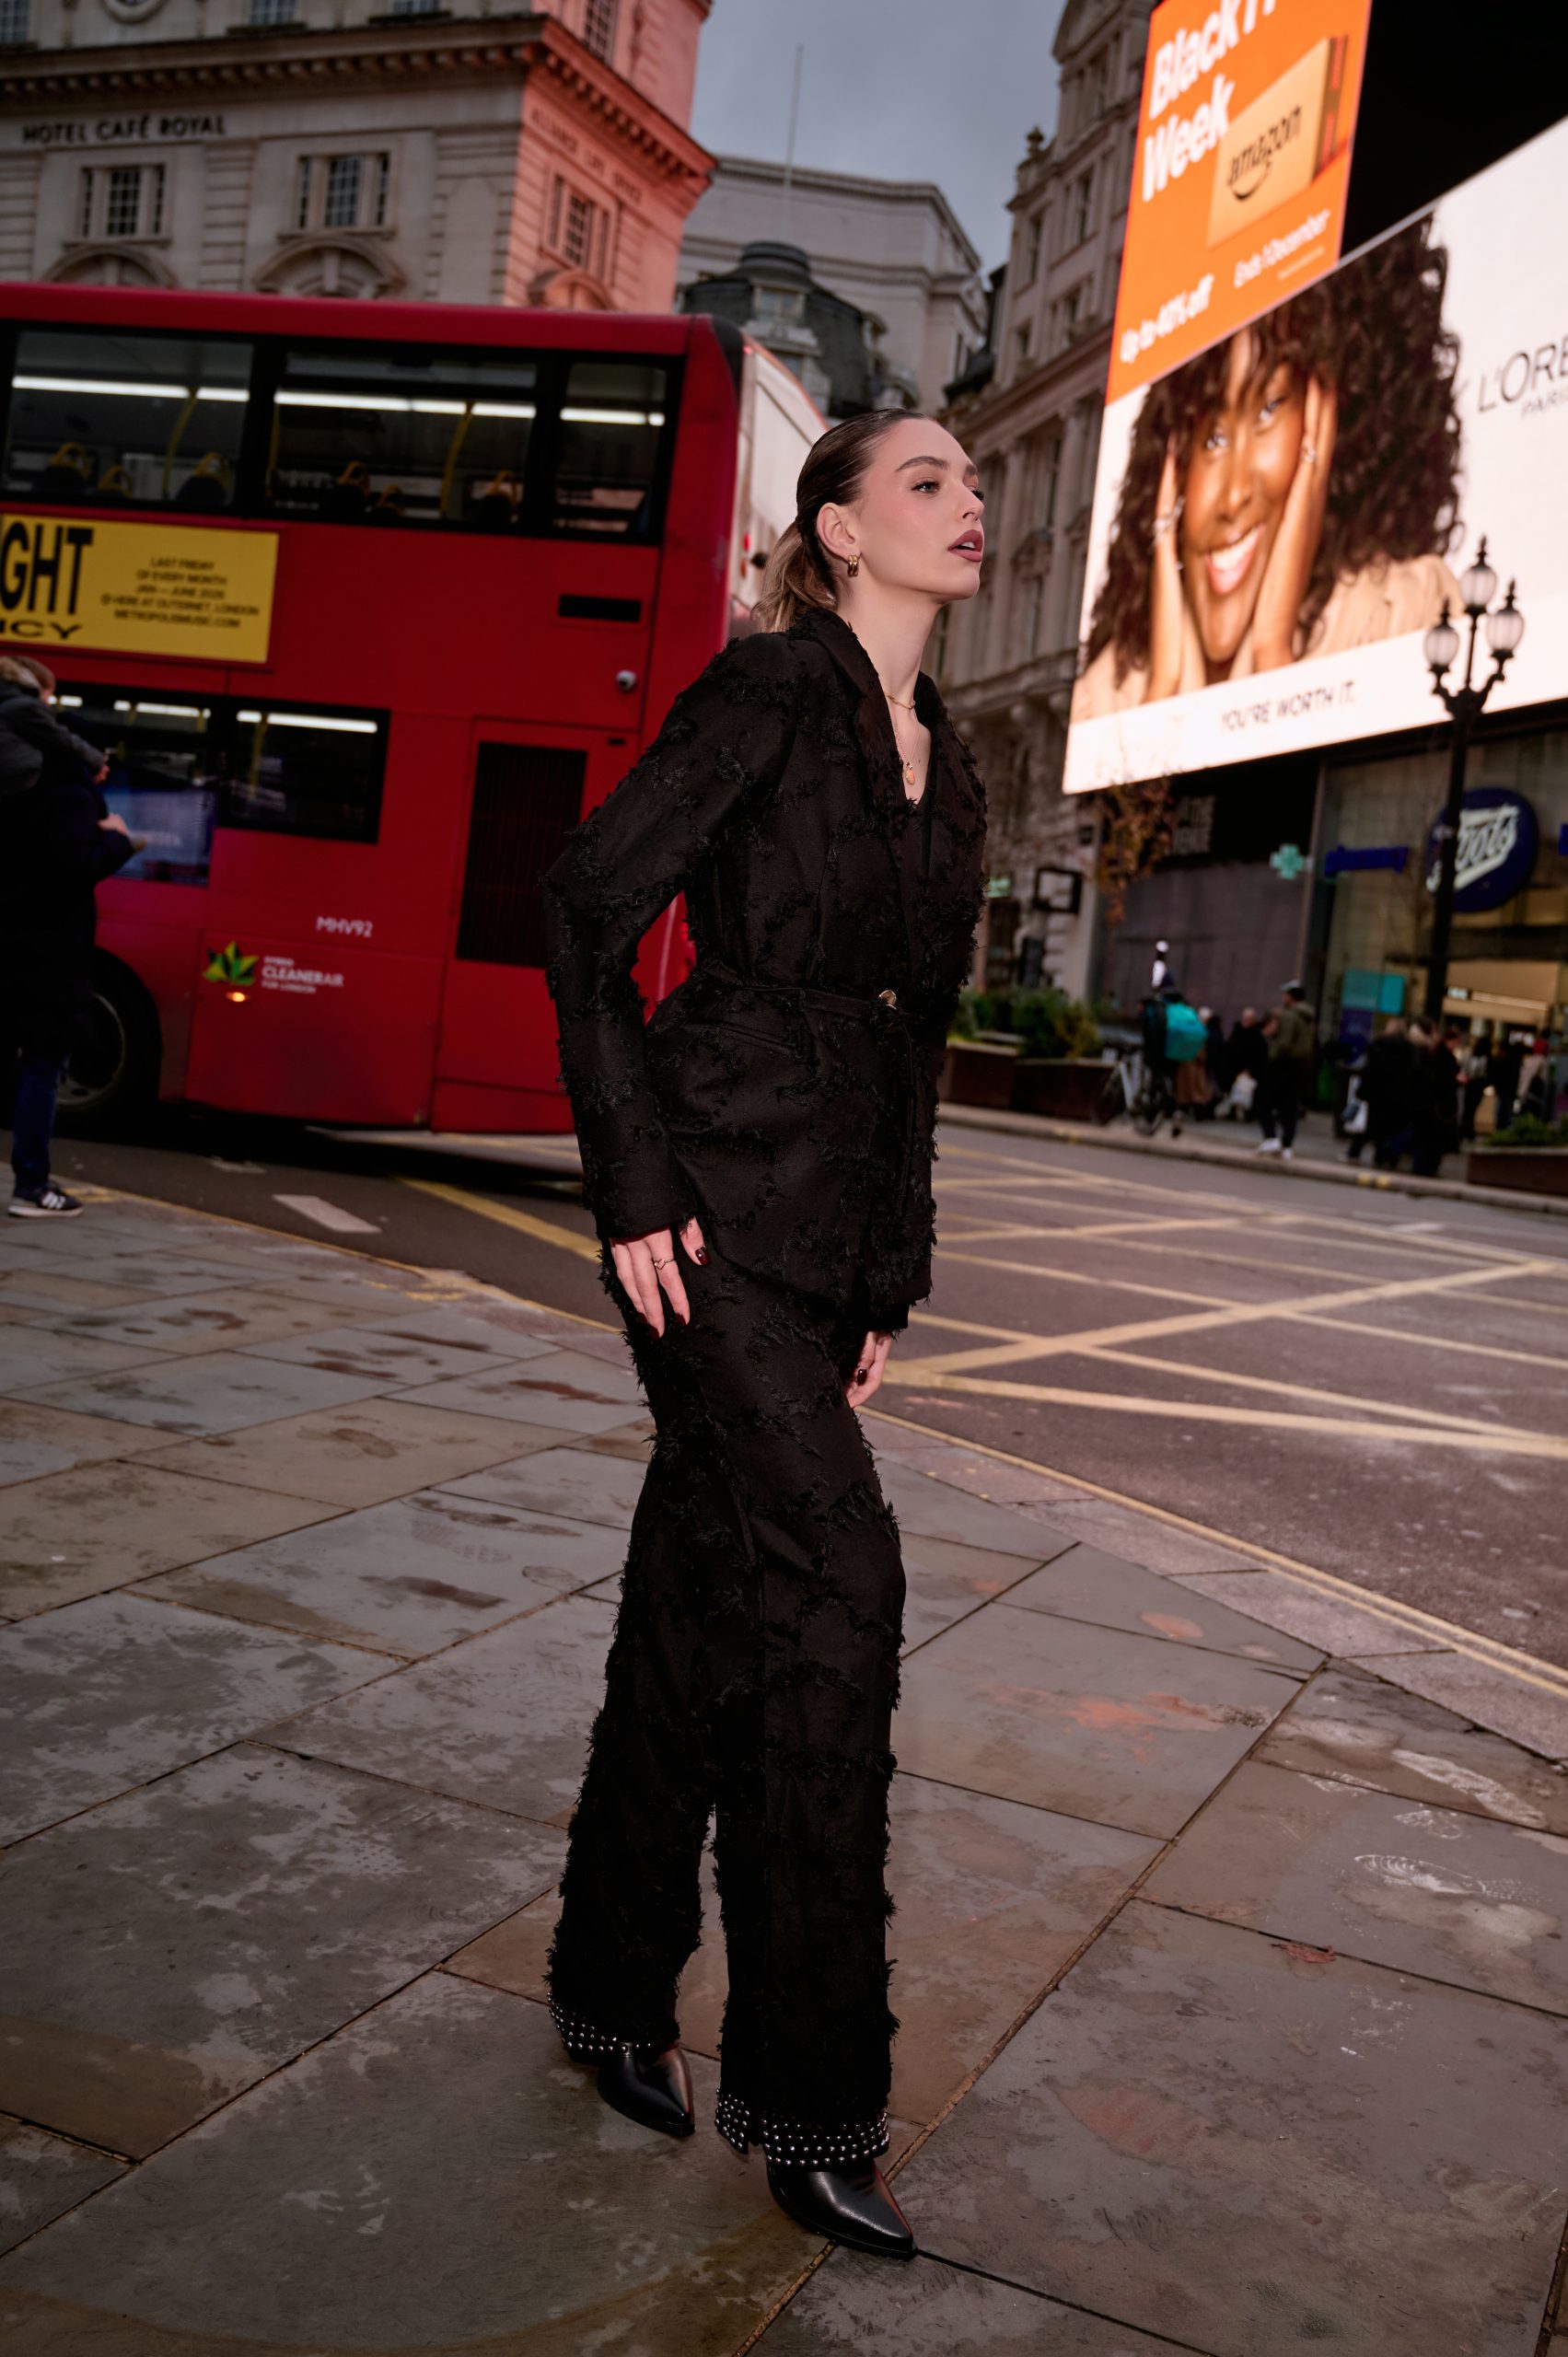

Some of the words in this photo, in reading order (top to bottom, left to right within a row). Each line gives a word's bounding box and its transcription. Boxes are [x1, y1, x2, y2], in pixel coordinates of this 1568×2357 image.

[1150, 0, 1240, 120] Black
[22, 122, 87, 145] HOTEL
[96, 112, 149, 141] CAFÉ
[160, 115, 225, 136] ROYAL
[1143, 74, 1235, 202] Week
[1227, 105, 1301, 186] amazon
[1121, 329, 1140, 364] Up
[1138, 320, 1156, 351] to
[1156, 291, 1188, 338] 40%
[1186, 273, 1214, 318] off
[136, 569, 150, 580] OF
[152, 571, 184, 582] EVERY
[187, 574, 227, 586] MONTH
[150, 557, 177, 568] LAST
[179, 559, 215, 571] FRIDAY
[136, 584, 157, 594] JAN
[171, 586, 195, 597] JUNE
[0, 619, 82, 640] CY
[1222, 700, 1271, 731] YOU'RE
[1277, 686, 1335, 718] WORTH
[316, 914, 374, 938] MHV92
[280, 982, 316, 993] LONDON
